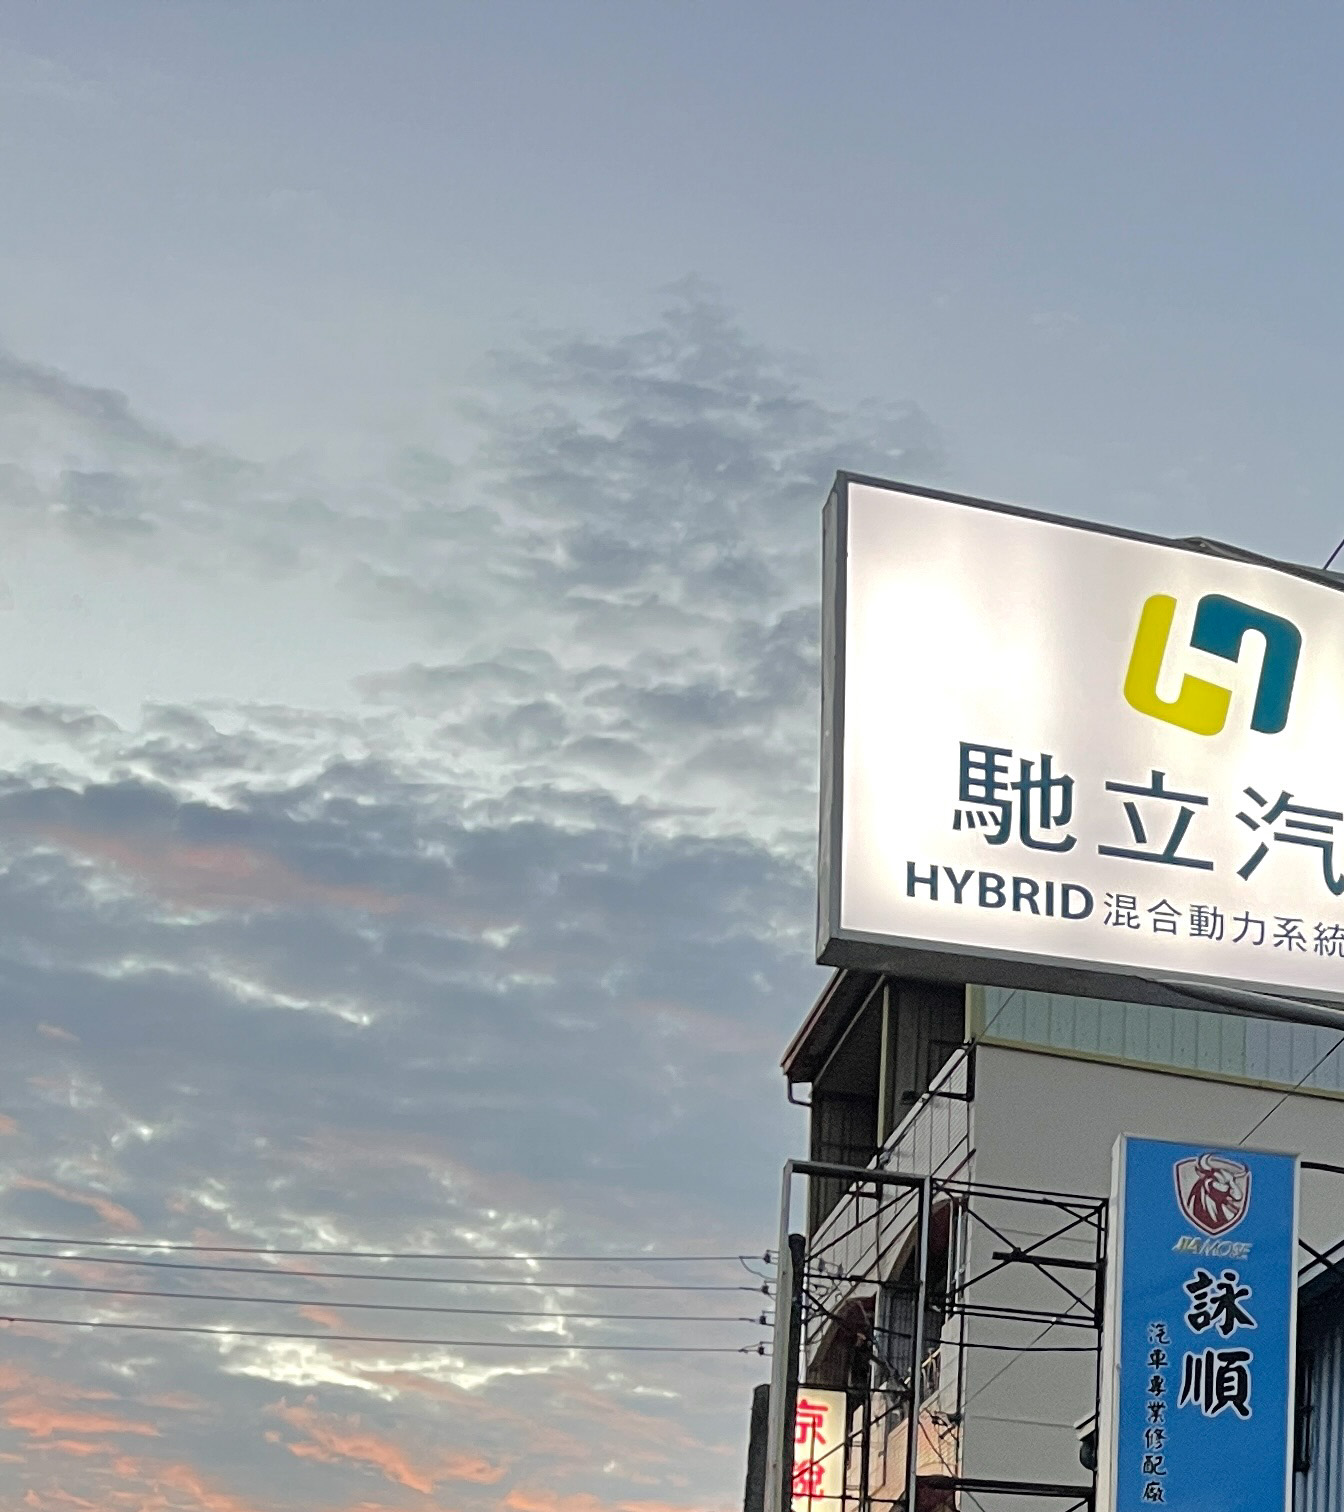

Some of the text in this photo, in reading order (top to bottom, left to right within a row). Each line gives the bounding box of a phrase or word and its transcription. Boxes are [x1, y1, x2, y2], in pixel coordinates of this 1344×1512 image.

[905, 860, 1095, 921] HYBRID
[1142, 1322, 1171, 1503] 汽車專業修配廠
[1178, 1269, 1257, 1418] 詠順
